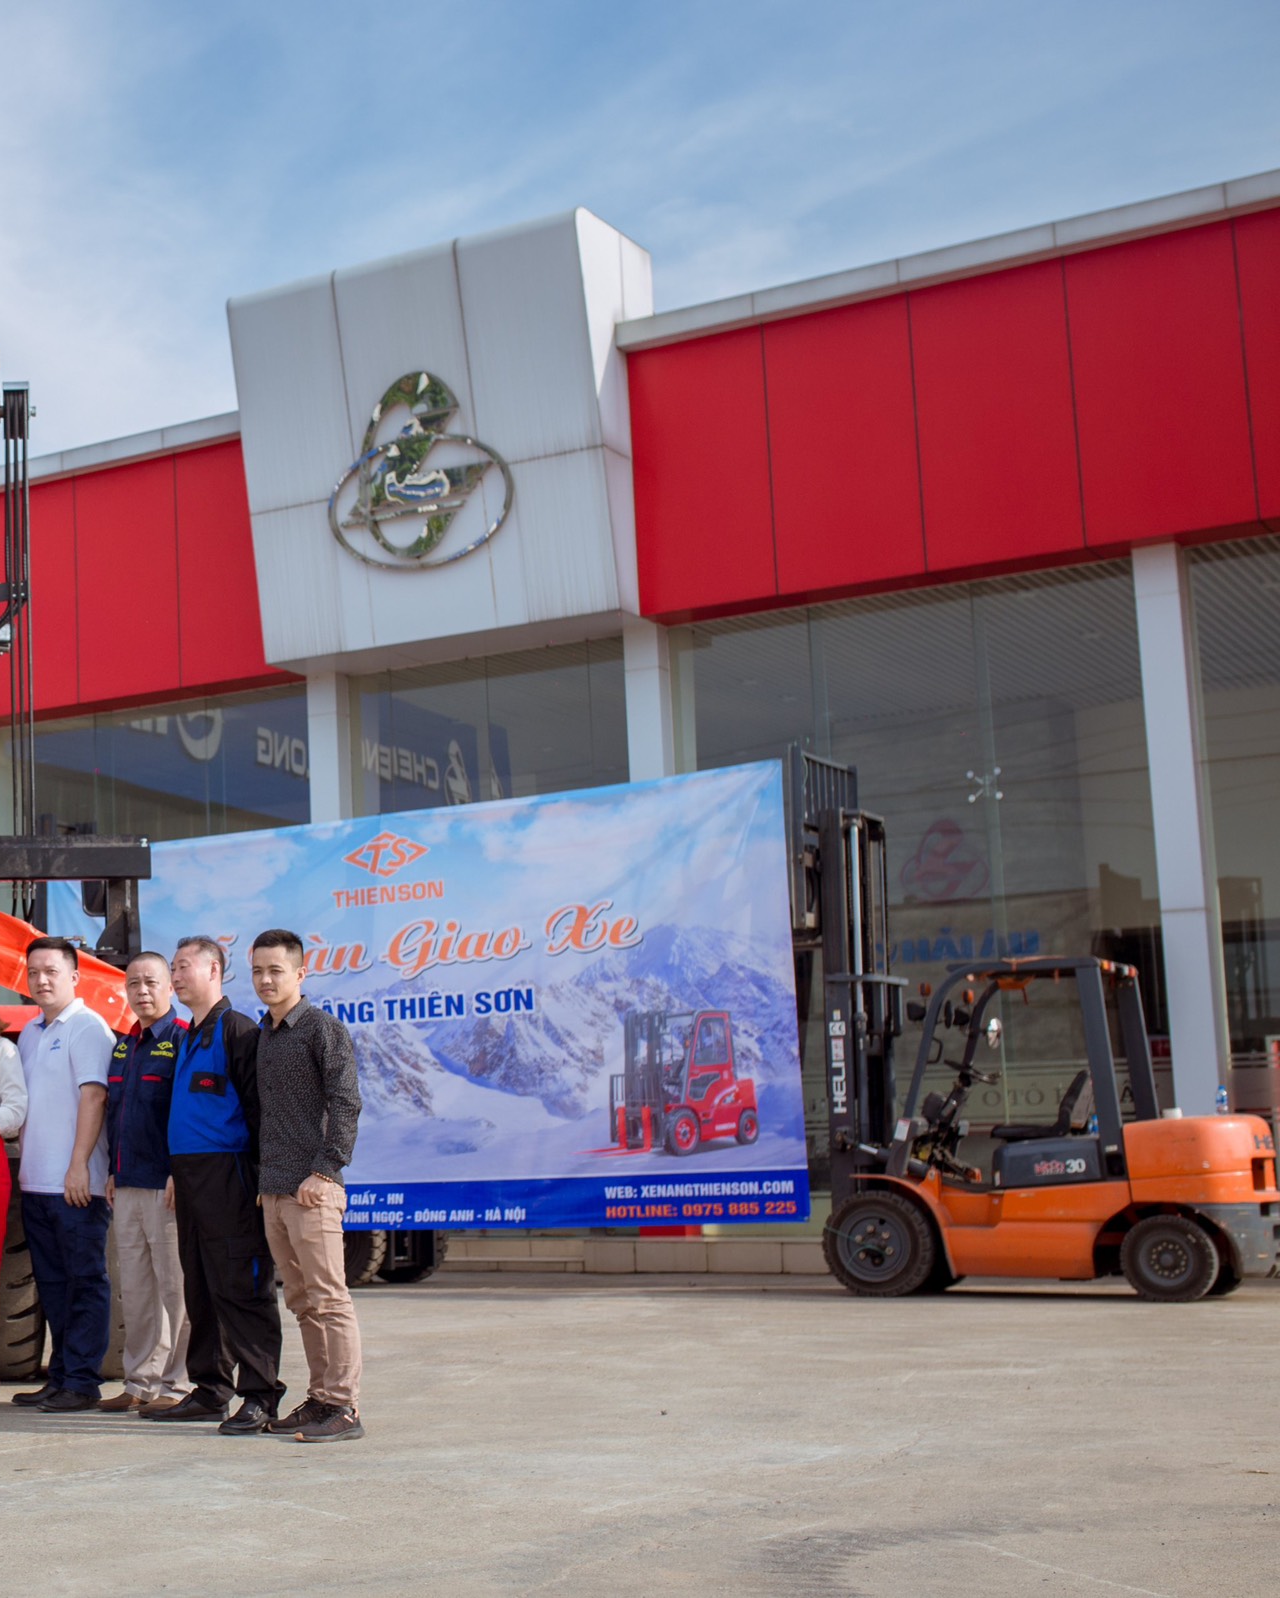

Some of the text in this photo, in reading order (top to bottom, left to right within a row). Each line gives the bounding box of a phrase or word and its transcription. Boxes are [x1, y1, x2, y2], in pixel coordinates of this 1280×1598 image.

[332, 879, 444, 909] THIENSON
[303, 934, 370, 975] àn
[380, 918, 530, 978] Giao
[545, 900, 642, 955] Xe
[322, 988, 534, 1024] ÂNG THIÊN SƠN
[1065, 1158, 1086, 1174] 30
[604, 1180, 795, 1199] WEB: XENANGTHIENSON.COM
[387, 1193, 404, 1205] HN
[449, 1209, 474, 1222] ANH
[485, 1206, 502, 1222] HÀ
[605, 1201, 797, 1219] HOTLINE: 0975 885 225
